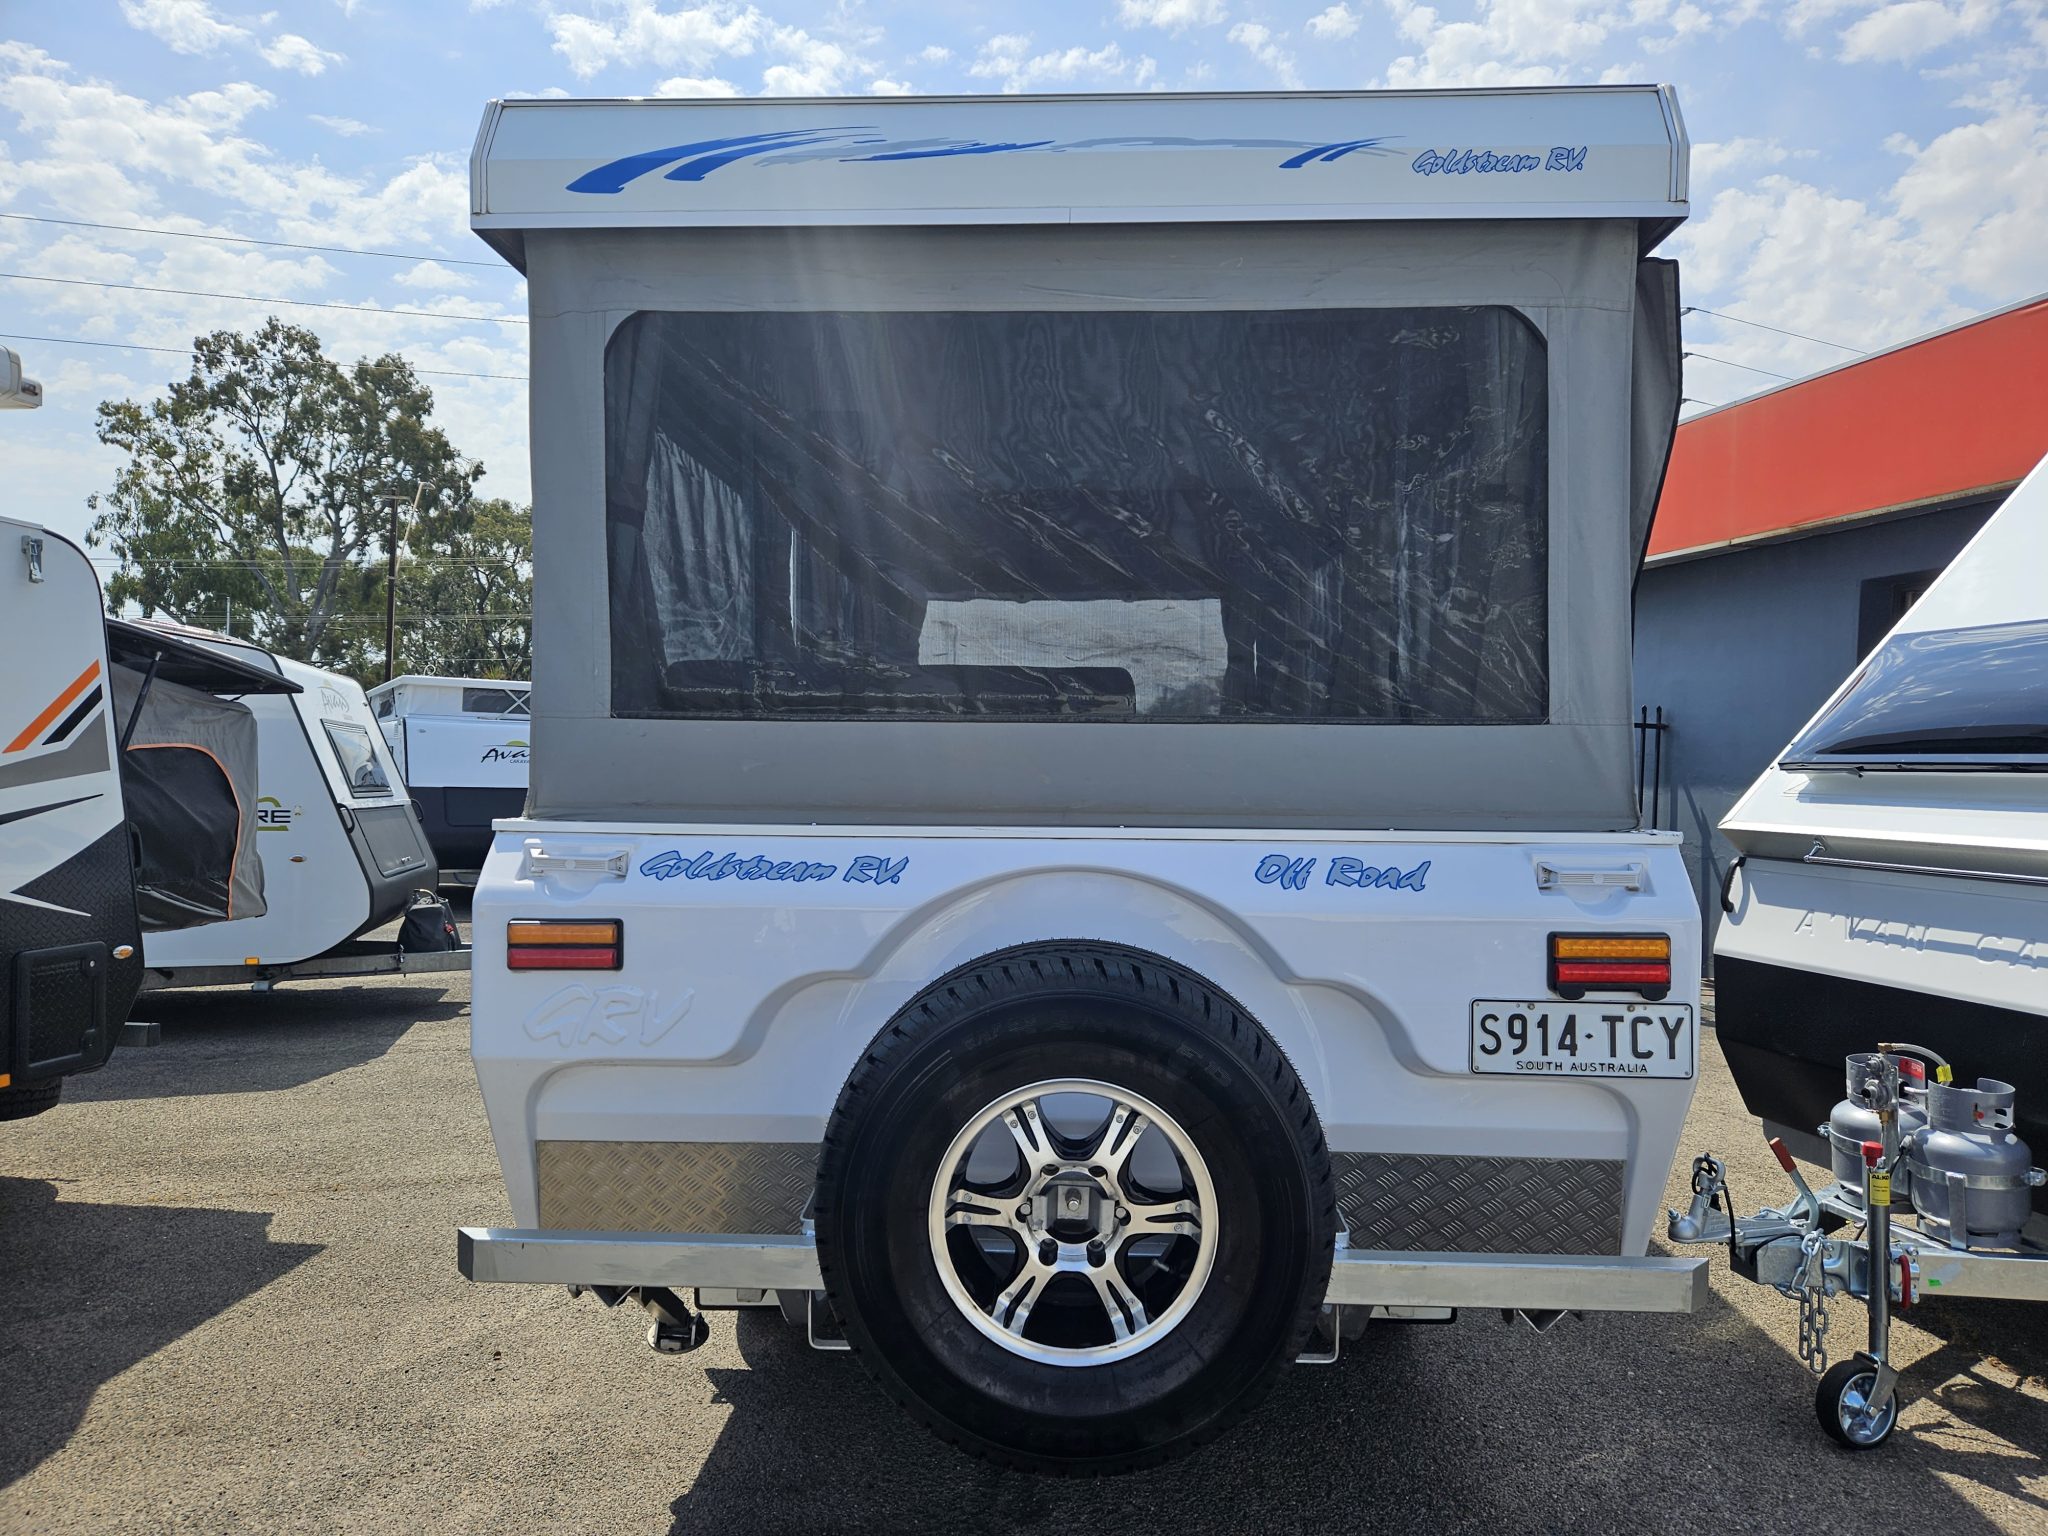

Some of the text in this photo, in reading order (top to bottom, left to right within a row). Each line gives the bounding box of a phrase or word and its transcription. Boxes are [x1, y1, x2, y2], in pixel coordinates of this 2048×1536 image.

[1411, 149, 1540, 176] Goldstream
[480, 747, 530, 763] Ava
[257, 809, 291, 823] RE
[639, 850, 837, 882] Goldstream
[1255, 854, 1432, 891] Off Road
[522, 982, 695, 1048] GRV
[1516, 1060, 1648, 1073] SOUTH AUSTRALIA
